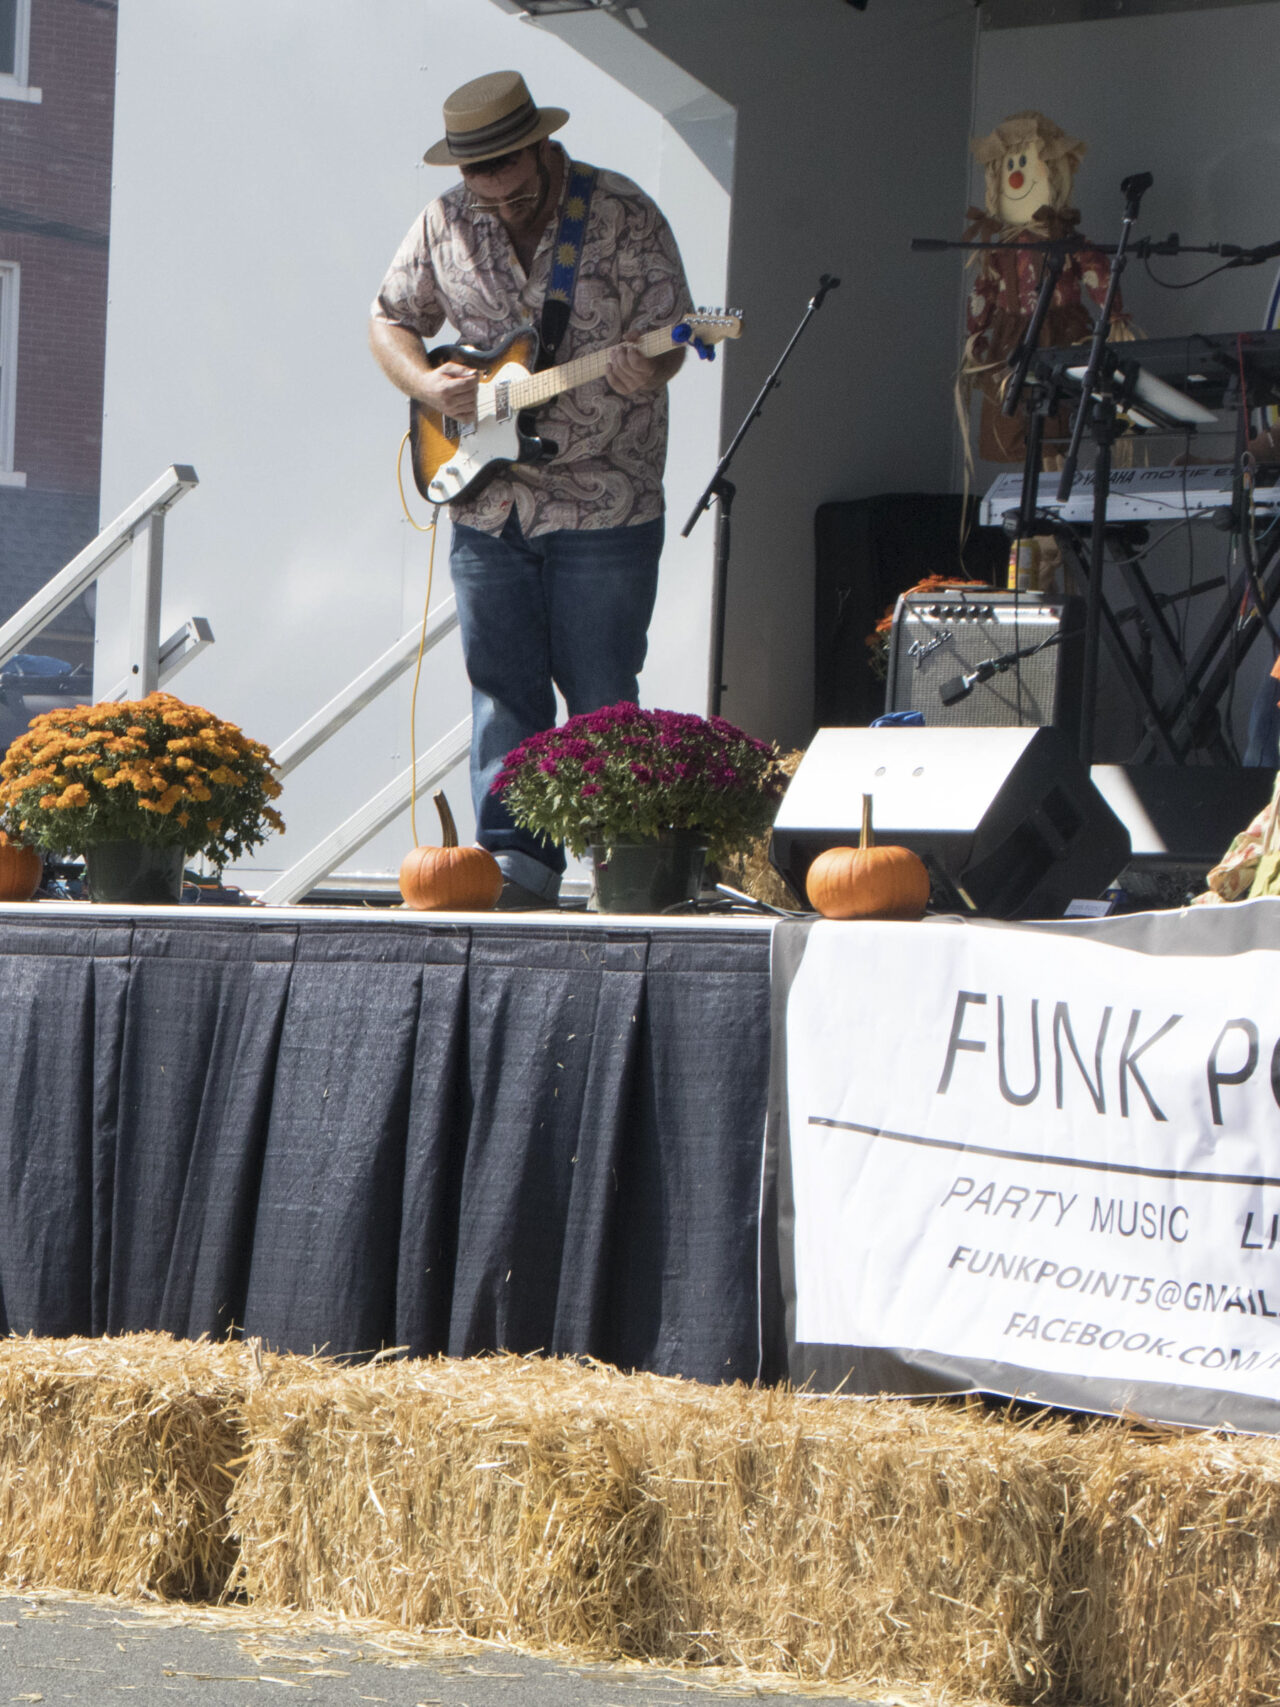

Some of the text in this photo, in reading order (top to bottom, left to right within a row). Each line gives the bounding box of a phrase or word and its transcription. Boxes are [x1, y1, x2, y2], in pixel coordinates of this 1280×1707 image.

[1081, 470, 1136, 486] YAAHA
[936, 990, 1280, 1126] FUNK P
[940, 1176, 1078, 1228] PARTY
[1090, 1196, 1190, 1243] MUSIC
[948, 1245, 1280, 1318] FUNKPOINT5@GMAIL
[1003, 1311, 1280, 1373] FACEBOOK.COM/
